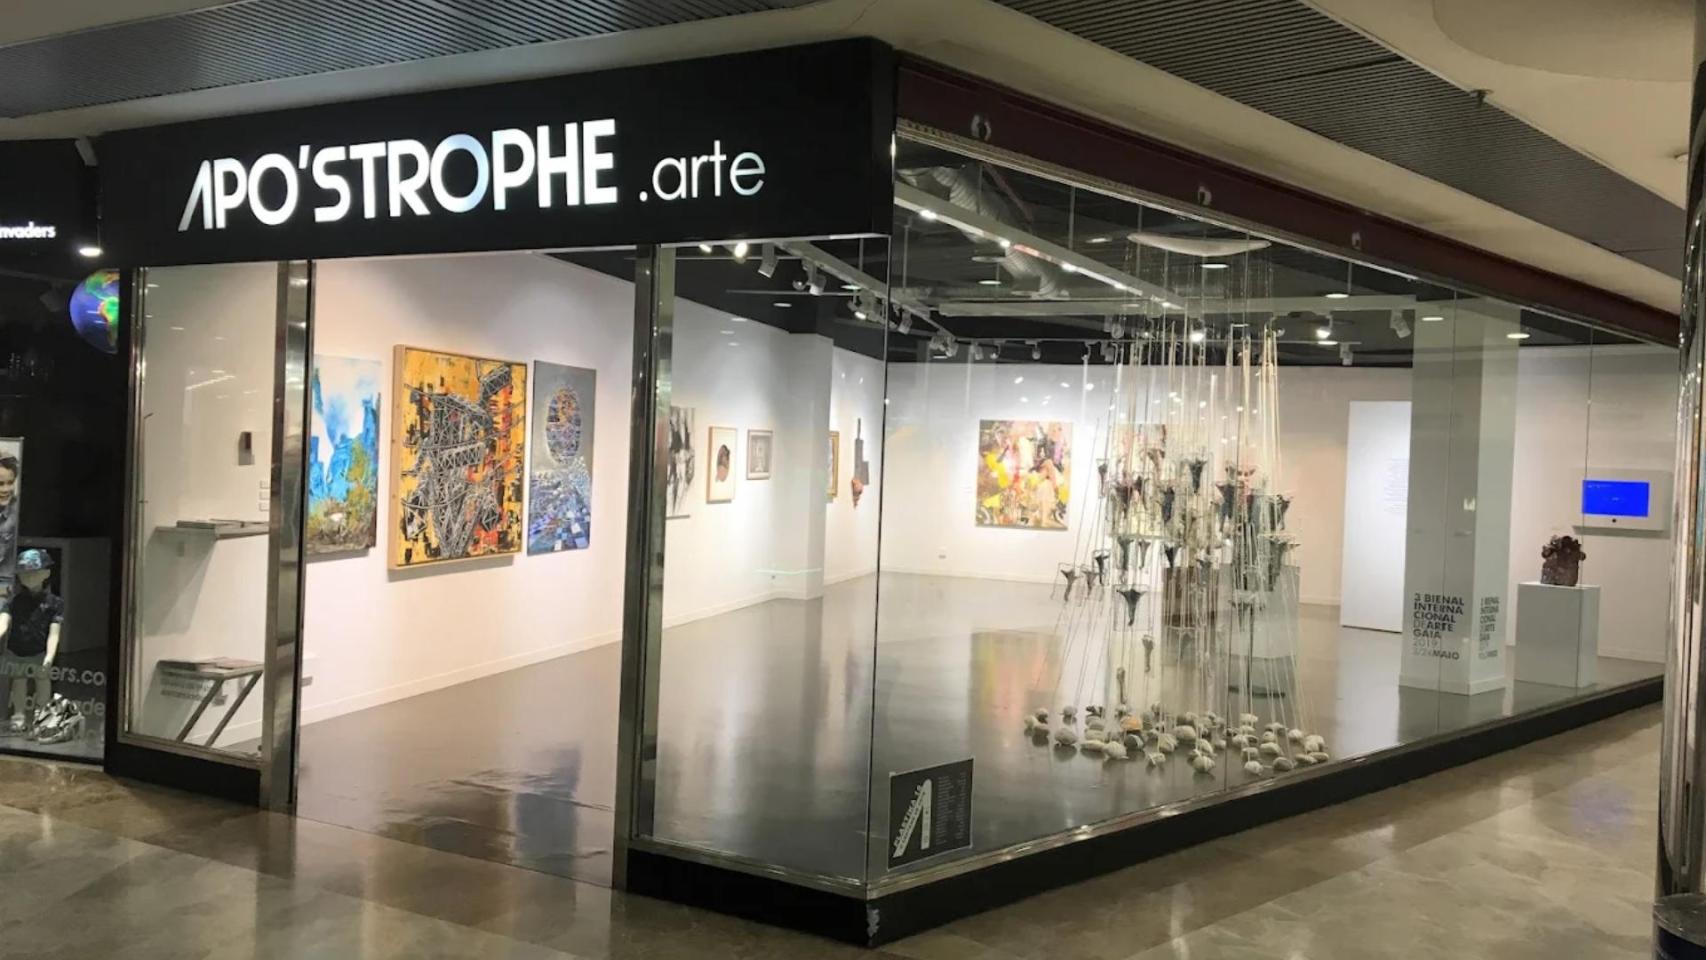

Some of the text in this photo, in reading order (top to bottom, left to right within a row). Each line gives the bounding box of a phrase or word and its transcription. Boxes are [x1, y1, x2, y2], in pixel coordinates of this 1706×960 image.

[1424, 594, 1465, 606] BIENAL
[1413, 602, 1464, 615] INTERNA
[1413, 610, 1457, 624] CIONAL
[1413, 628, 1442, 639] GAIA
